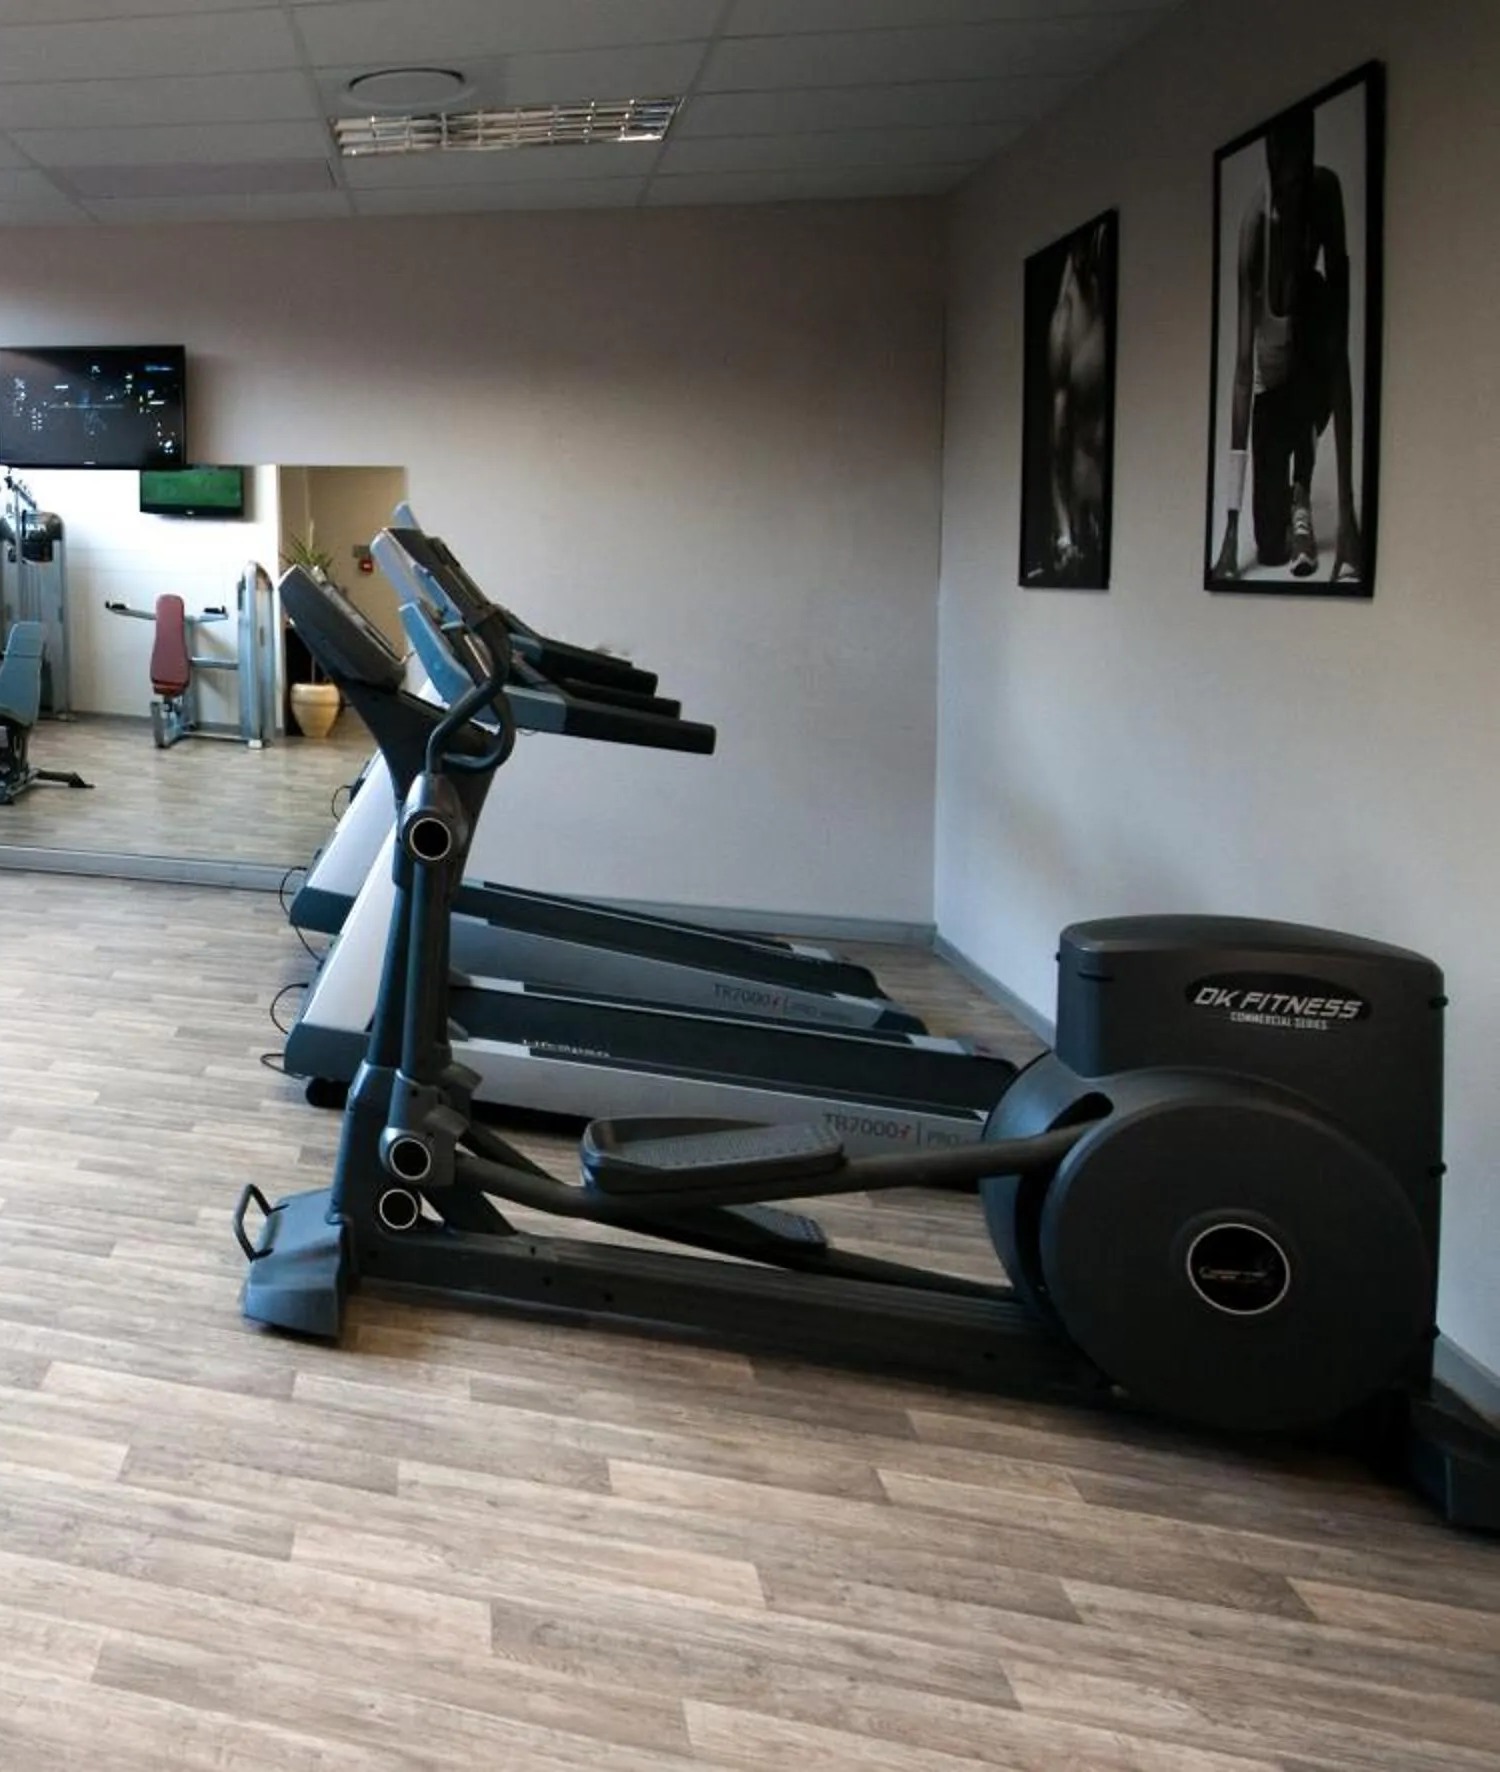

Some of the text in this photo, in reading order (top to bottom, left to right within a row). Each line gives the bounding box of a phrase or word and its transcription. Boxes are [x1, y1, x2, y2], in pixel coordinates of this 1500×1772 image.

[1194, 987, 1363, 1018] DK FITNESS
[1230, 1011, 1291, 1027] COMMERCIAL
